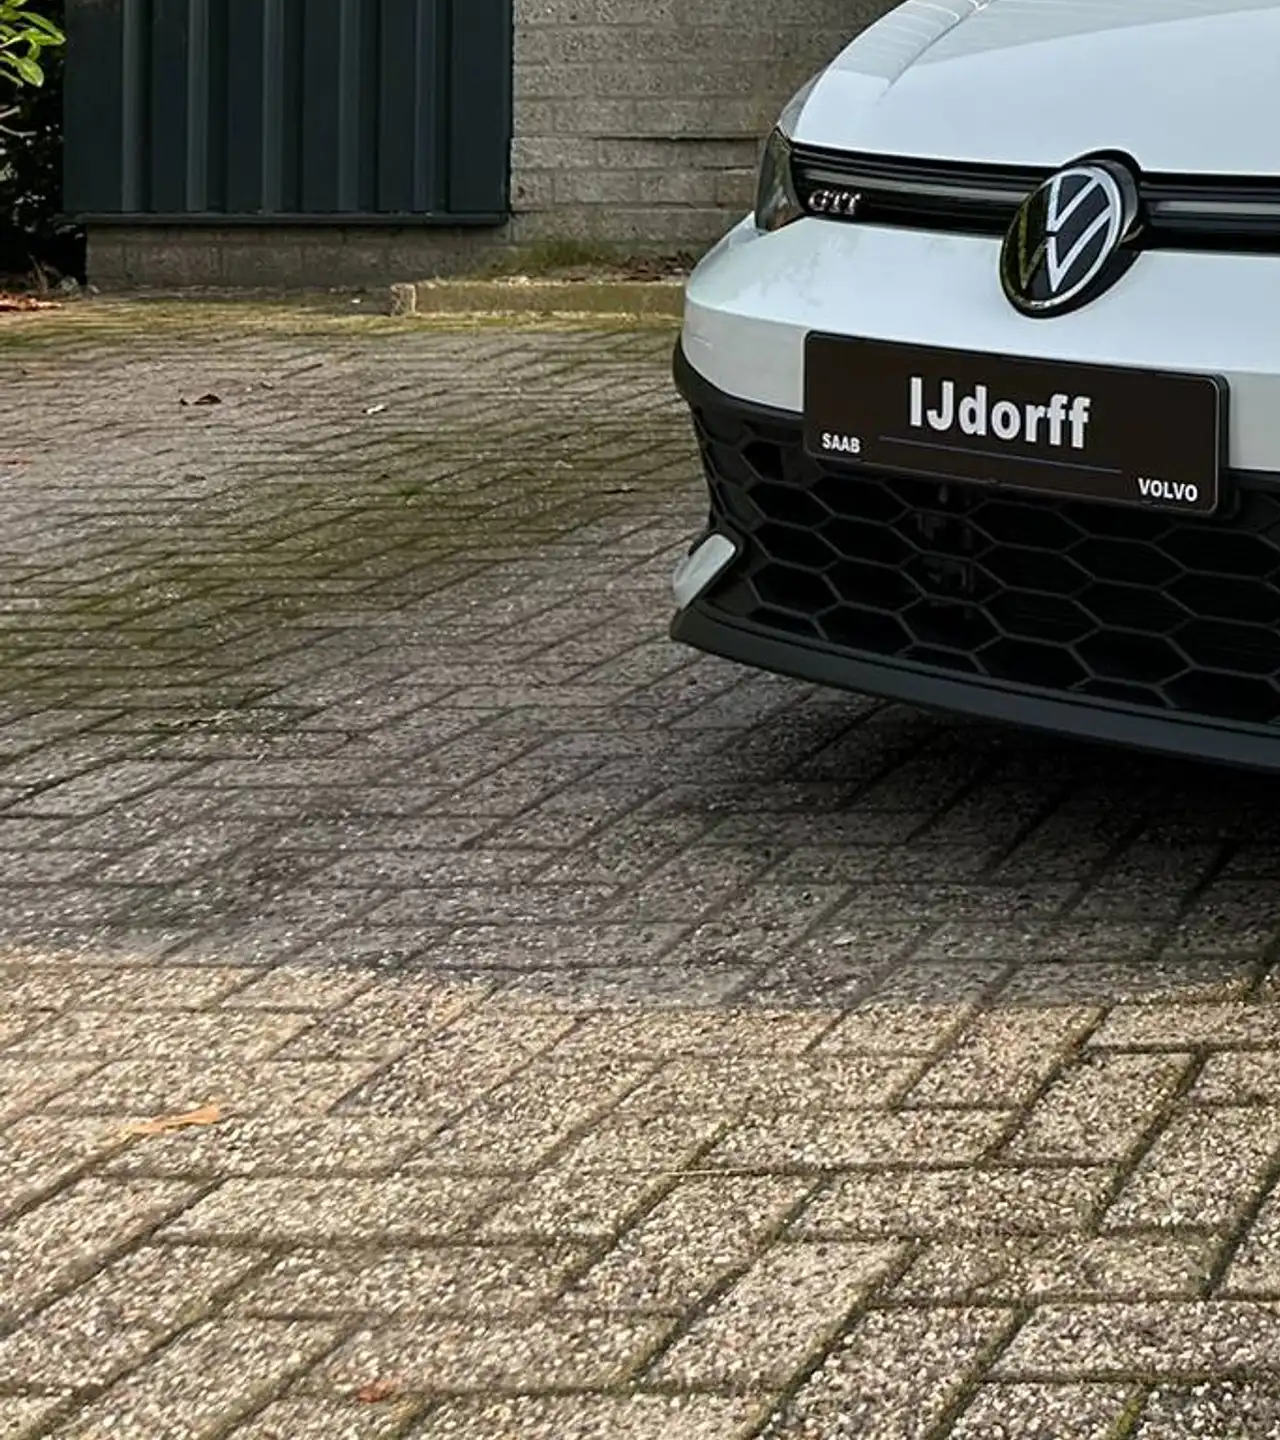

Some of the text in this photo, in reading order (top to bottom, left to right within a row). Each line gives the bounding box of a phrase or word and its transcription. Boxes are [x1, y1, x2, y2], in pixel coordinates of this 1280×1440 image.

[910, 376, 1091, 448] IJdorff
[821, 432, 861, 454] SAAB
[1138, 477, 1199, 502] VOLVO
